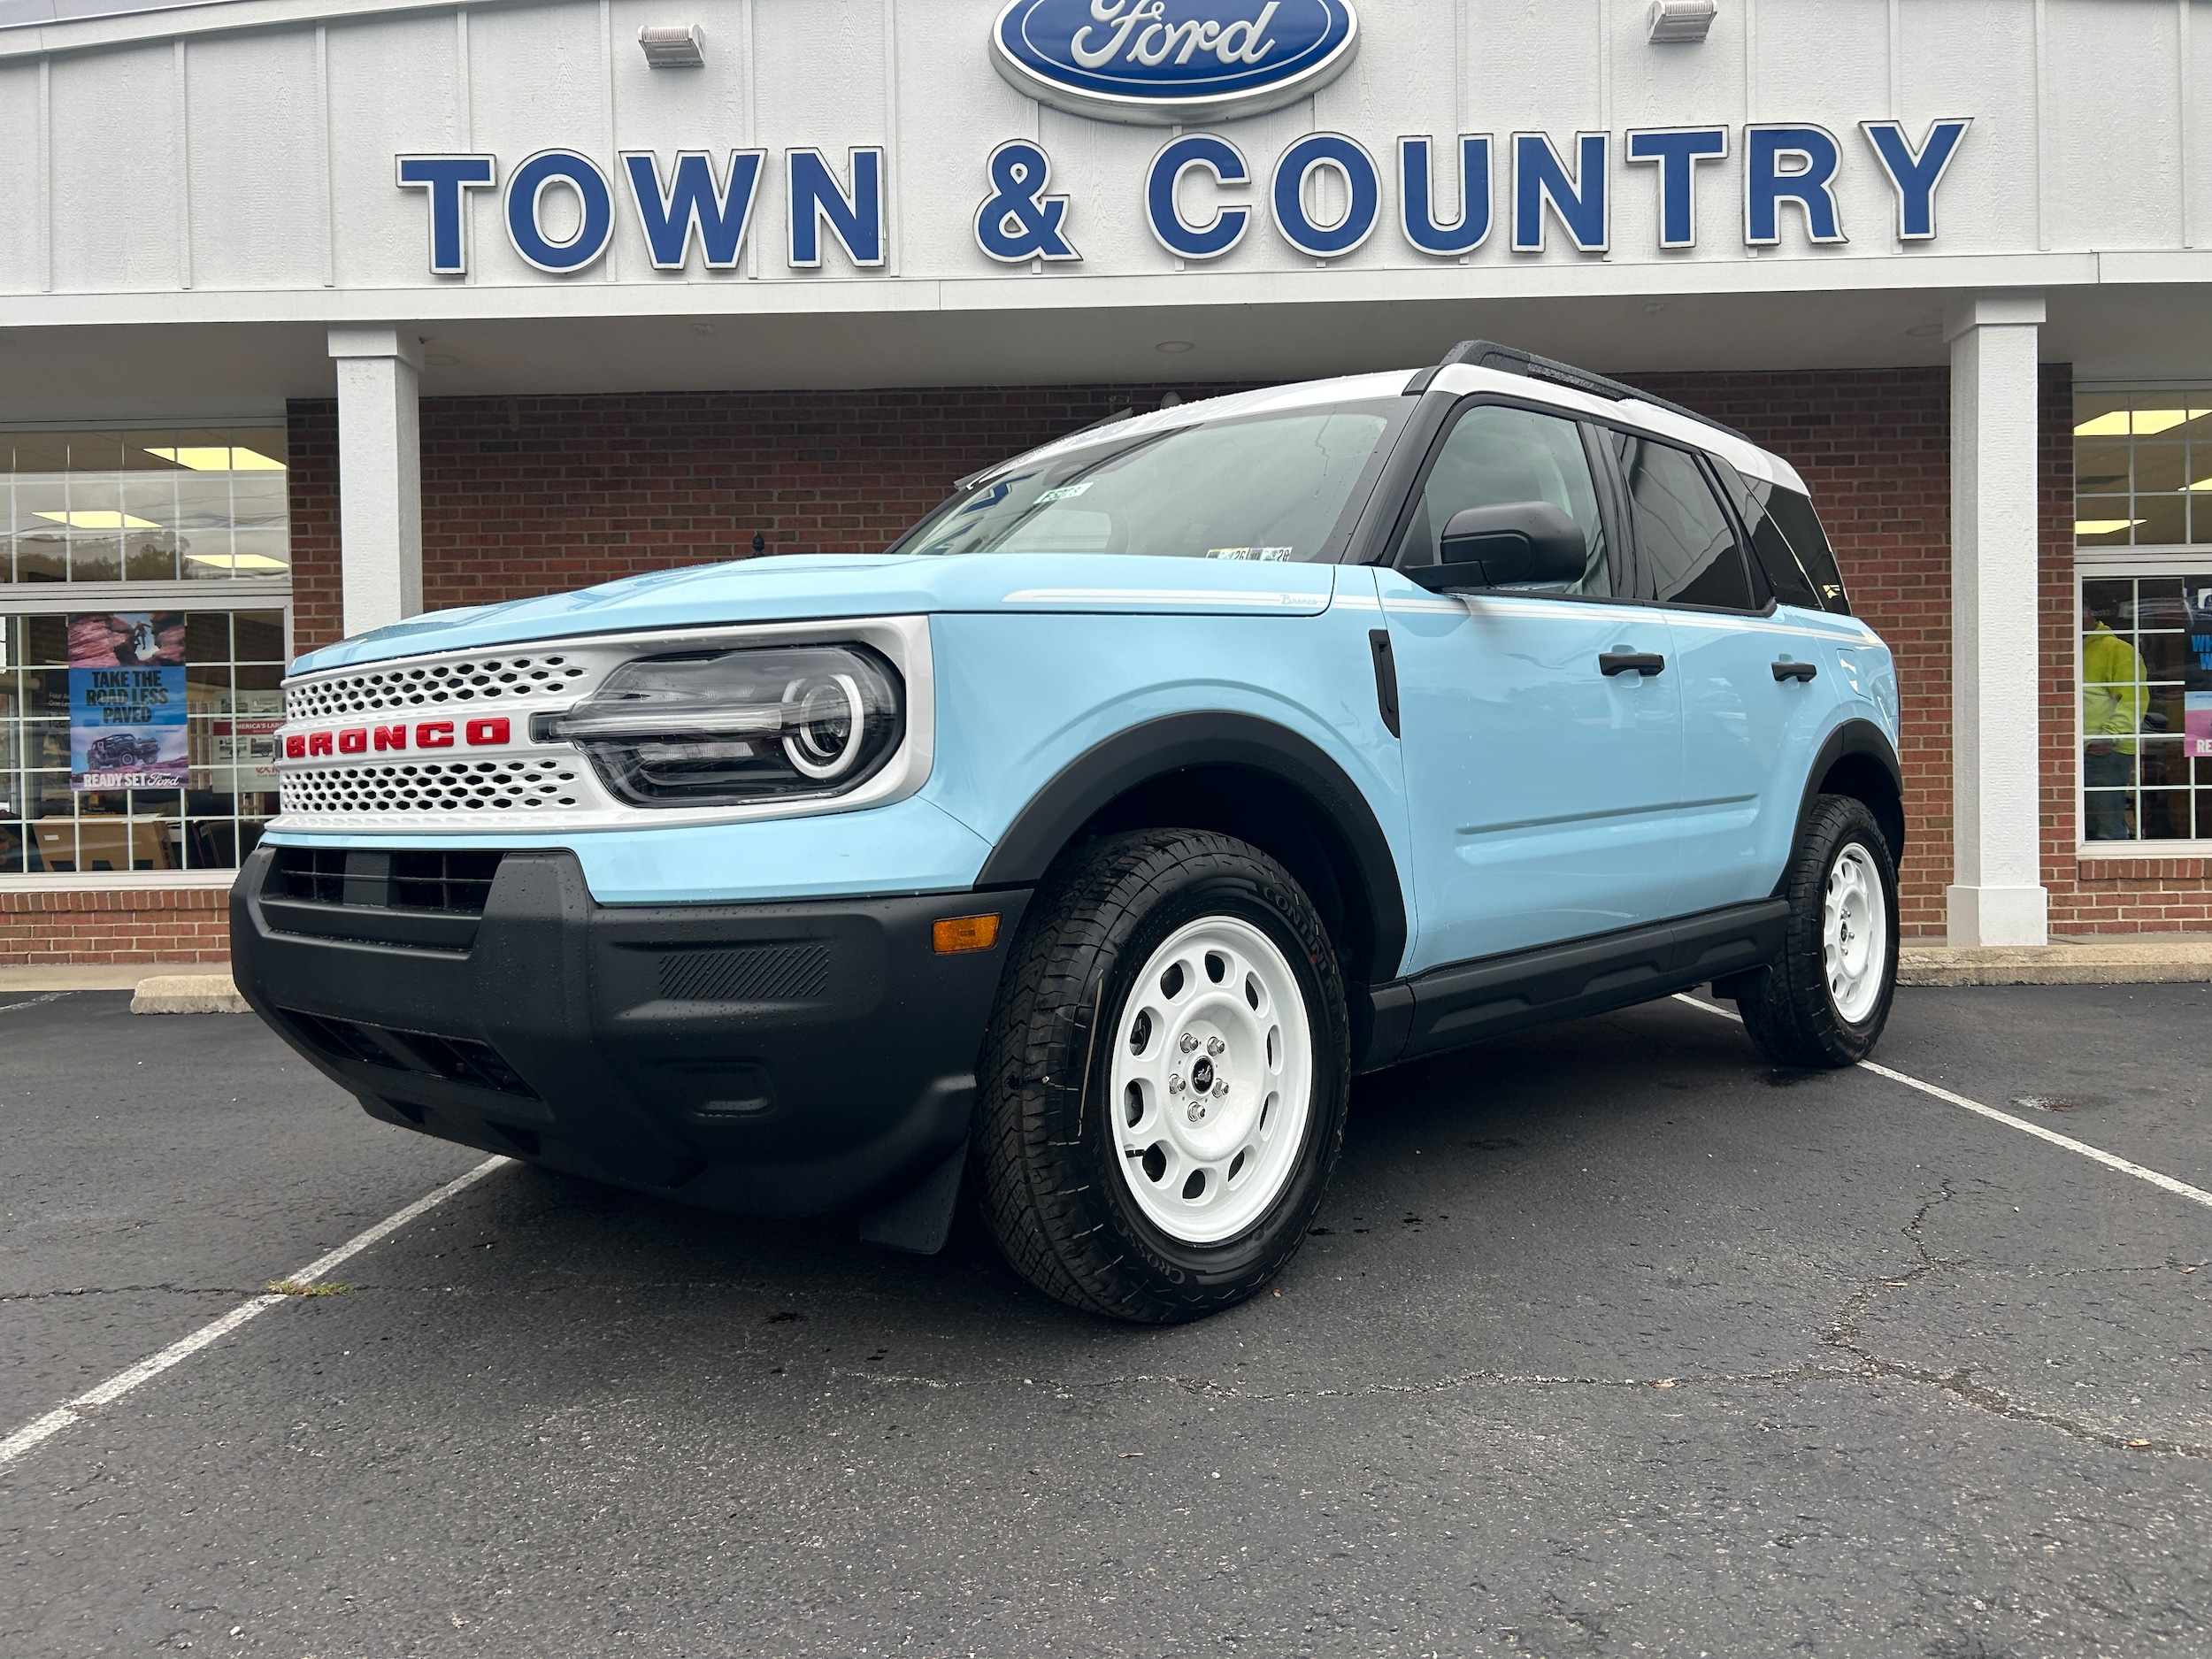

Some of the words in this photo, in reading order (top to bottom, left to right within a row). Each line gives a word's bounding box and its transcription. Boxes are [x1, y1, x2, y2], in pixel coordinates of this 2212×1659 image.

[1070, 0, 1281, 69] Ford
[395, 145, 887, 275] TOWN
[973, 139, 1084, 263] &
[1144, 116, 1975, 261] COUNTRY
[1279, 594, 1318, 605] Bronco
[91, 671, 131, 688] TAKE
[133, 670, 163, 687] THE
[86, 688, 129, 706] ROAD
[131, 687, 169, 705] LESS
[103, 706, 152, 724] PAVED
[231, 722, 266, 731] MERICA'S
[286, 717, 511, 759] BRONCO
[83, 773, 123, 788] READY
[124, 772, 147, 787] SET
[147, 771, 180, 787] Ford
